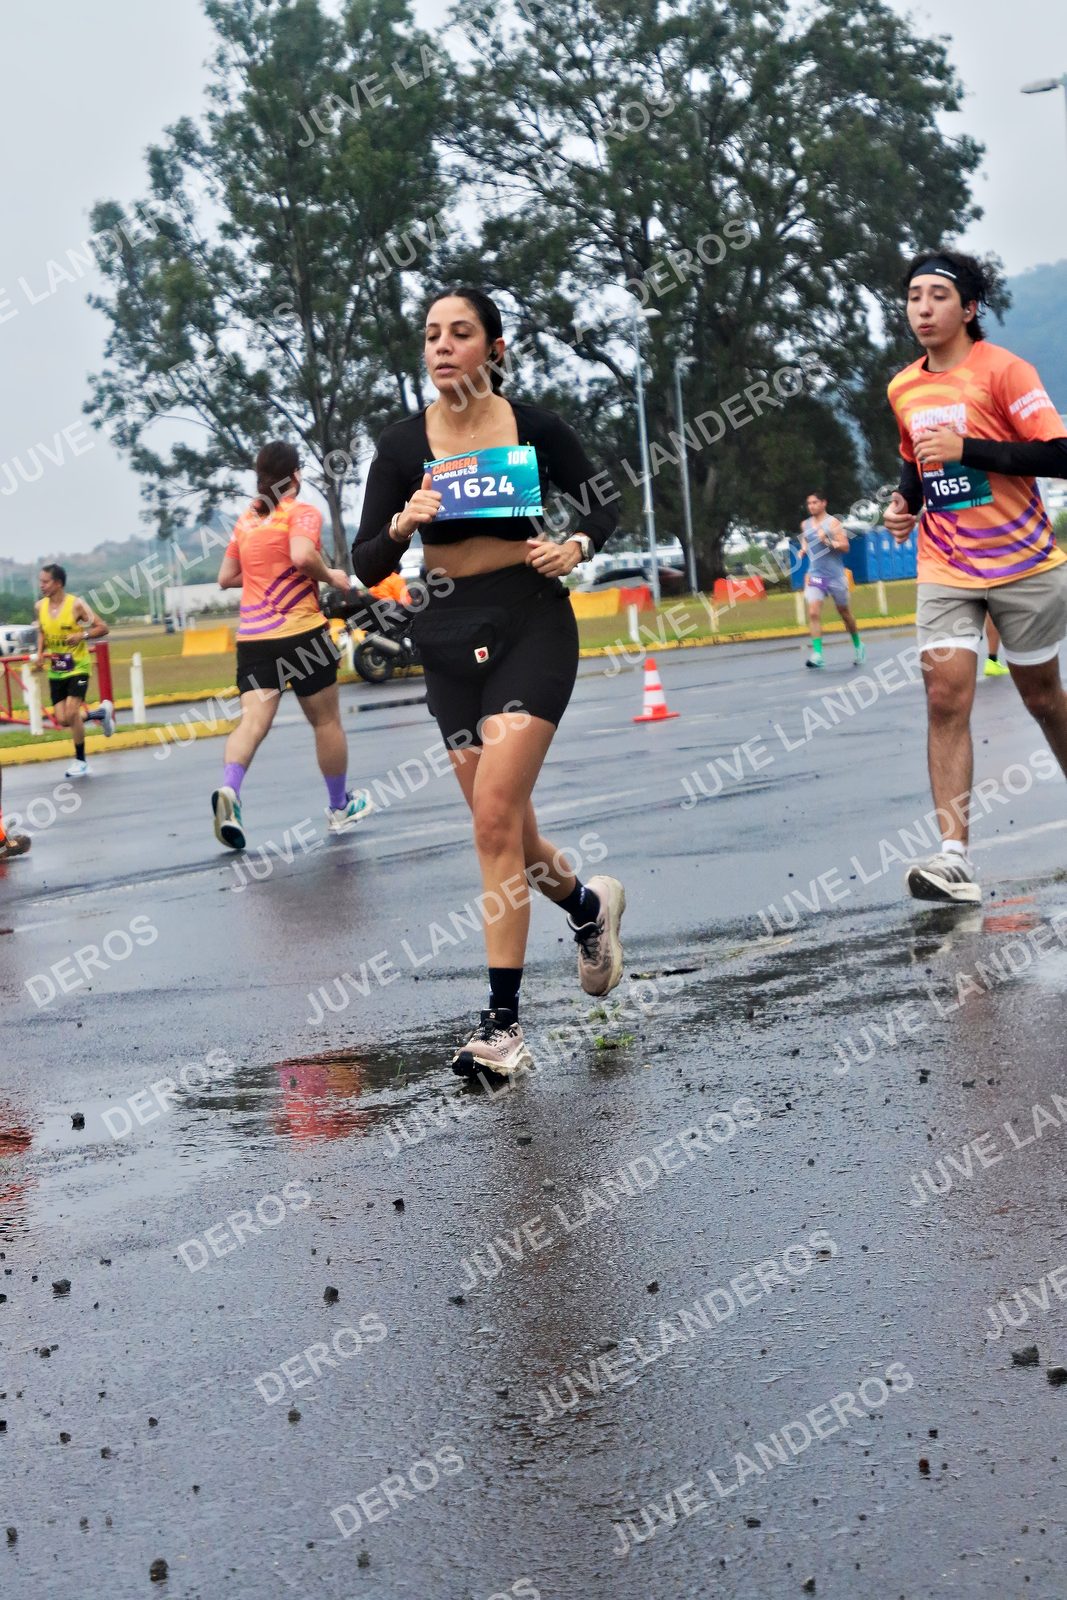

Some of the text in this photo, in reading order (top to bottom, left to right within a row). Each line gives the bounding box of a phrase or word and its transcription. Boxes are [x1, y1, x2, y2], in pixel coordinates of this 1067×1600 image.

[911, 403, 966, 432] CARRERA
[432, 457, 478, 475] CARRERA
[507, 451, 528, 465] 10K
[448, 476, 515, 500] 1624
[931, 476, 971, 496] 1655
